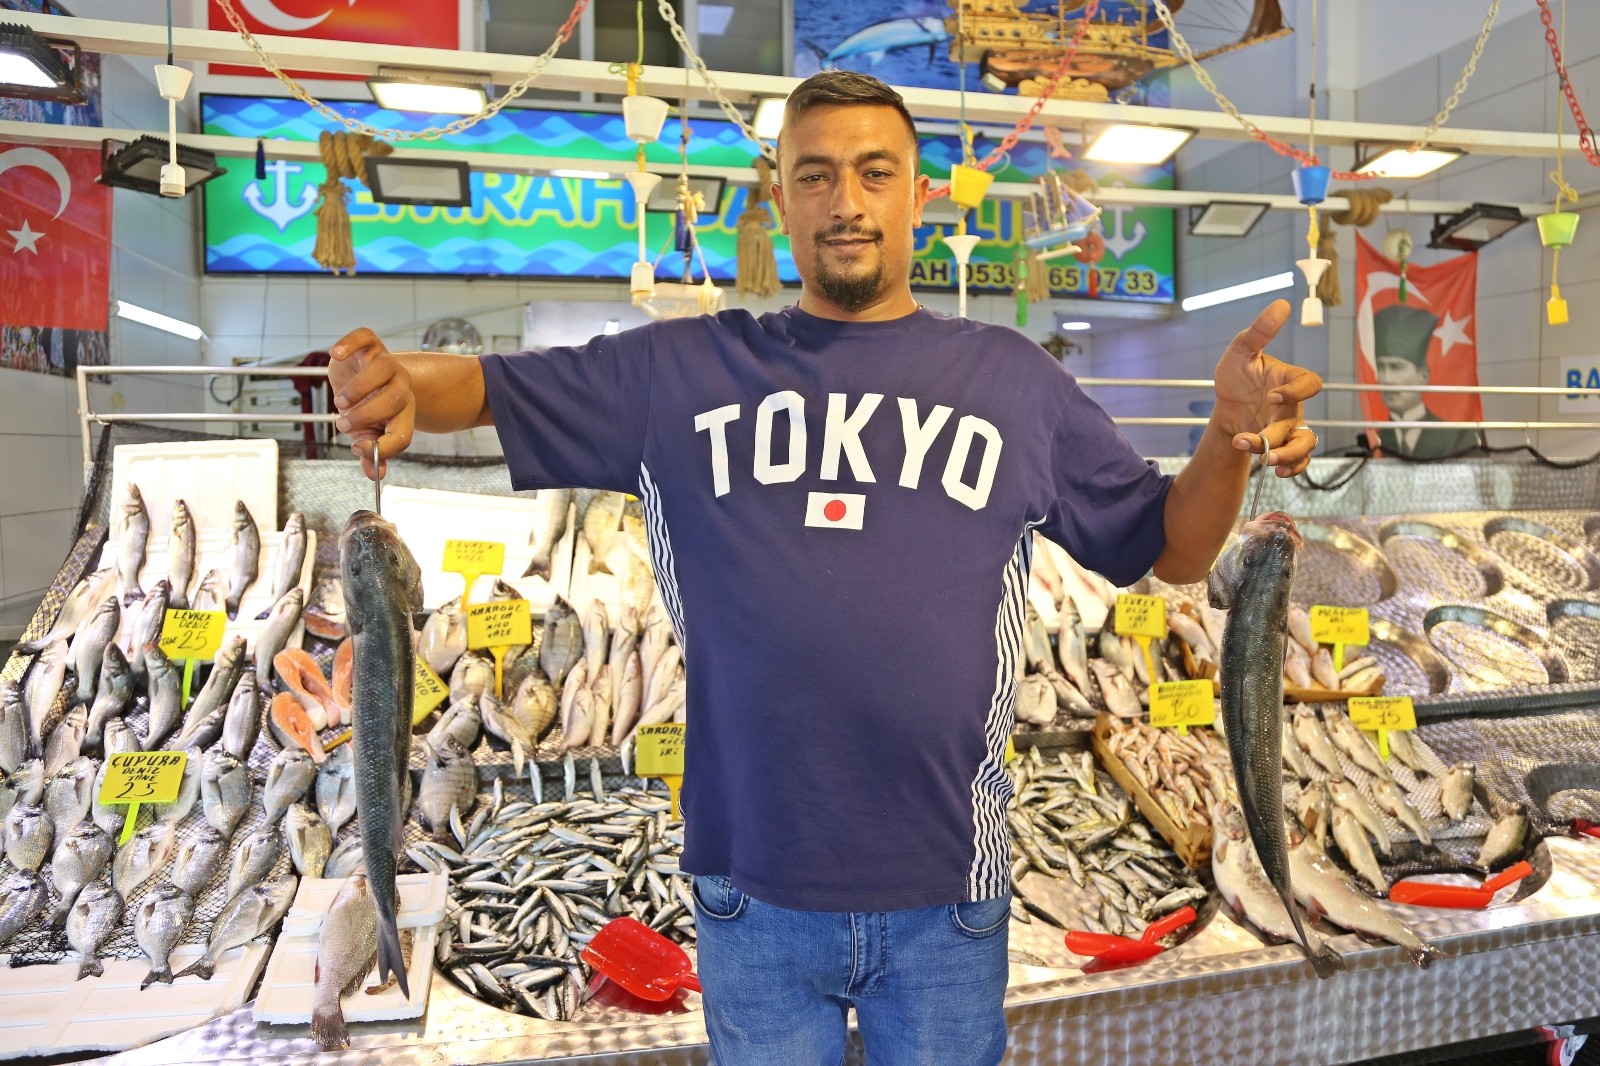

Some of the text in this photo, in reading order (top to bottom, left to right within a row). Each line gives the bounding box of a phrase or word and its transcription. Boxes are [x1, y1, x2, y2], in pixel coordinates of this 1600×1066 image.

[344, 171, 638, 224] ERAH
[1127, 271, 1154, 290] 33
[694, 390, 1004, 511] TOKYO
[177, 630, 208, 651] 25
[415, 663, 441, 694] OMON
[1377, 710, 1401, 725] 15
[111, 755, 182, 769] ÇUPURA
[115, 782, 158, 799] 25
